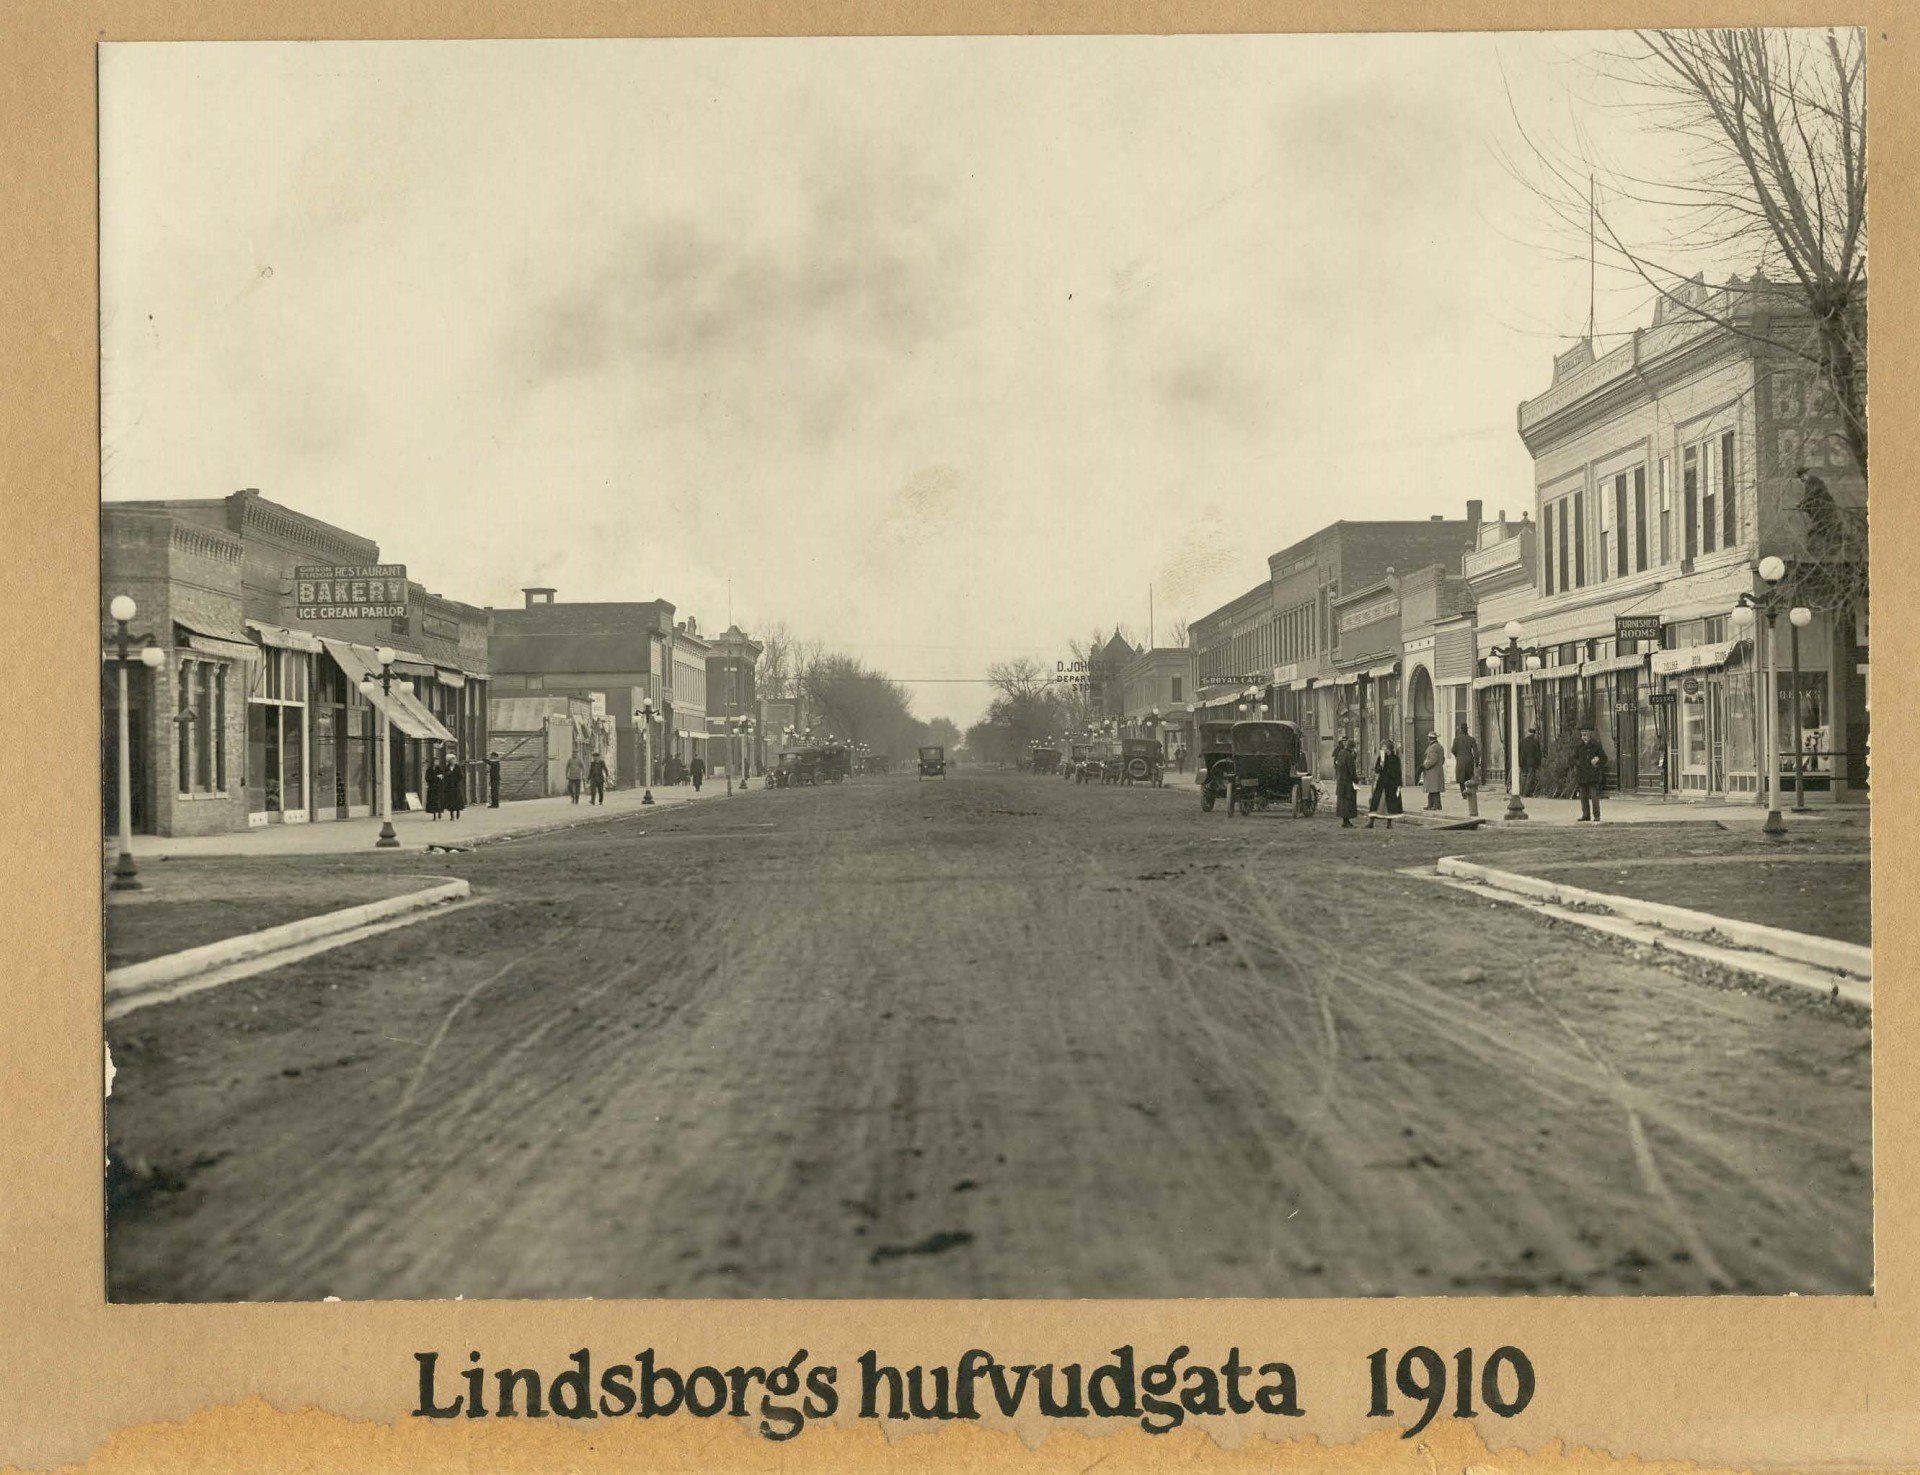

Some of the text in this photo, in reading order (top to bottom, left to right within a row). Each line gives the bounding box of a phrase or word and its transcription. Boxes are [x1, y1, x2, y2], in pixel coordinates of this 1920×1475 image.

[335, 566, 402, 578] RESTAURANT
[299, 581, 402, 603] BAKERY
[299, 606, 405, 618] ICE CREAM PARLOR
[1617, 619, 1658, 629] FURNISHED
[1620, 628, 1656, 638] ROOMS
[1210, 676, 1239, 685] ROYAL
